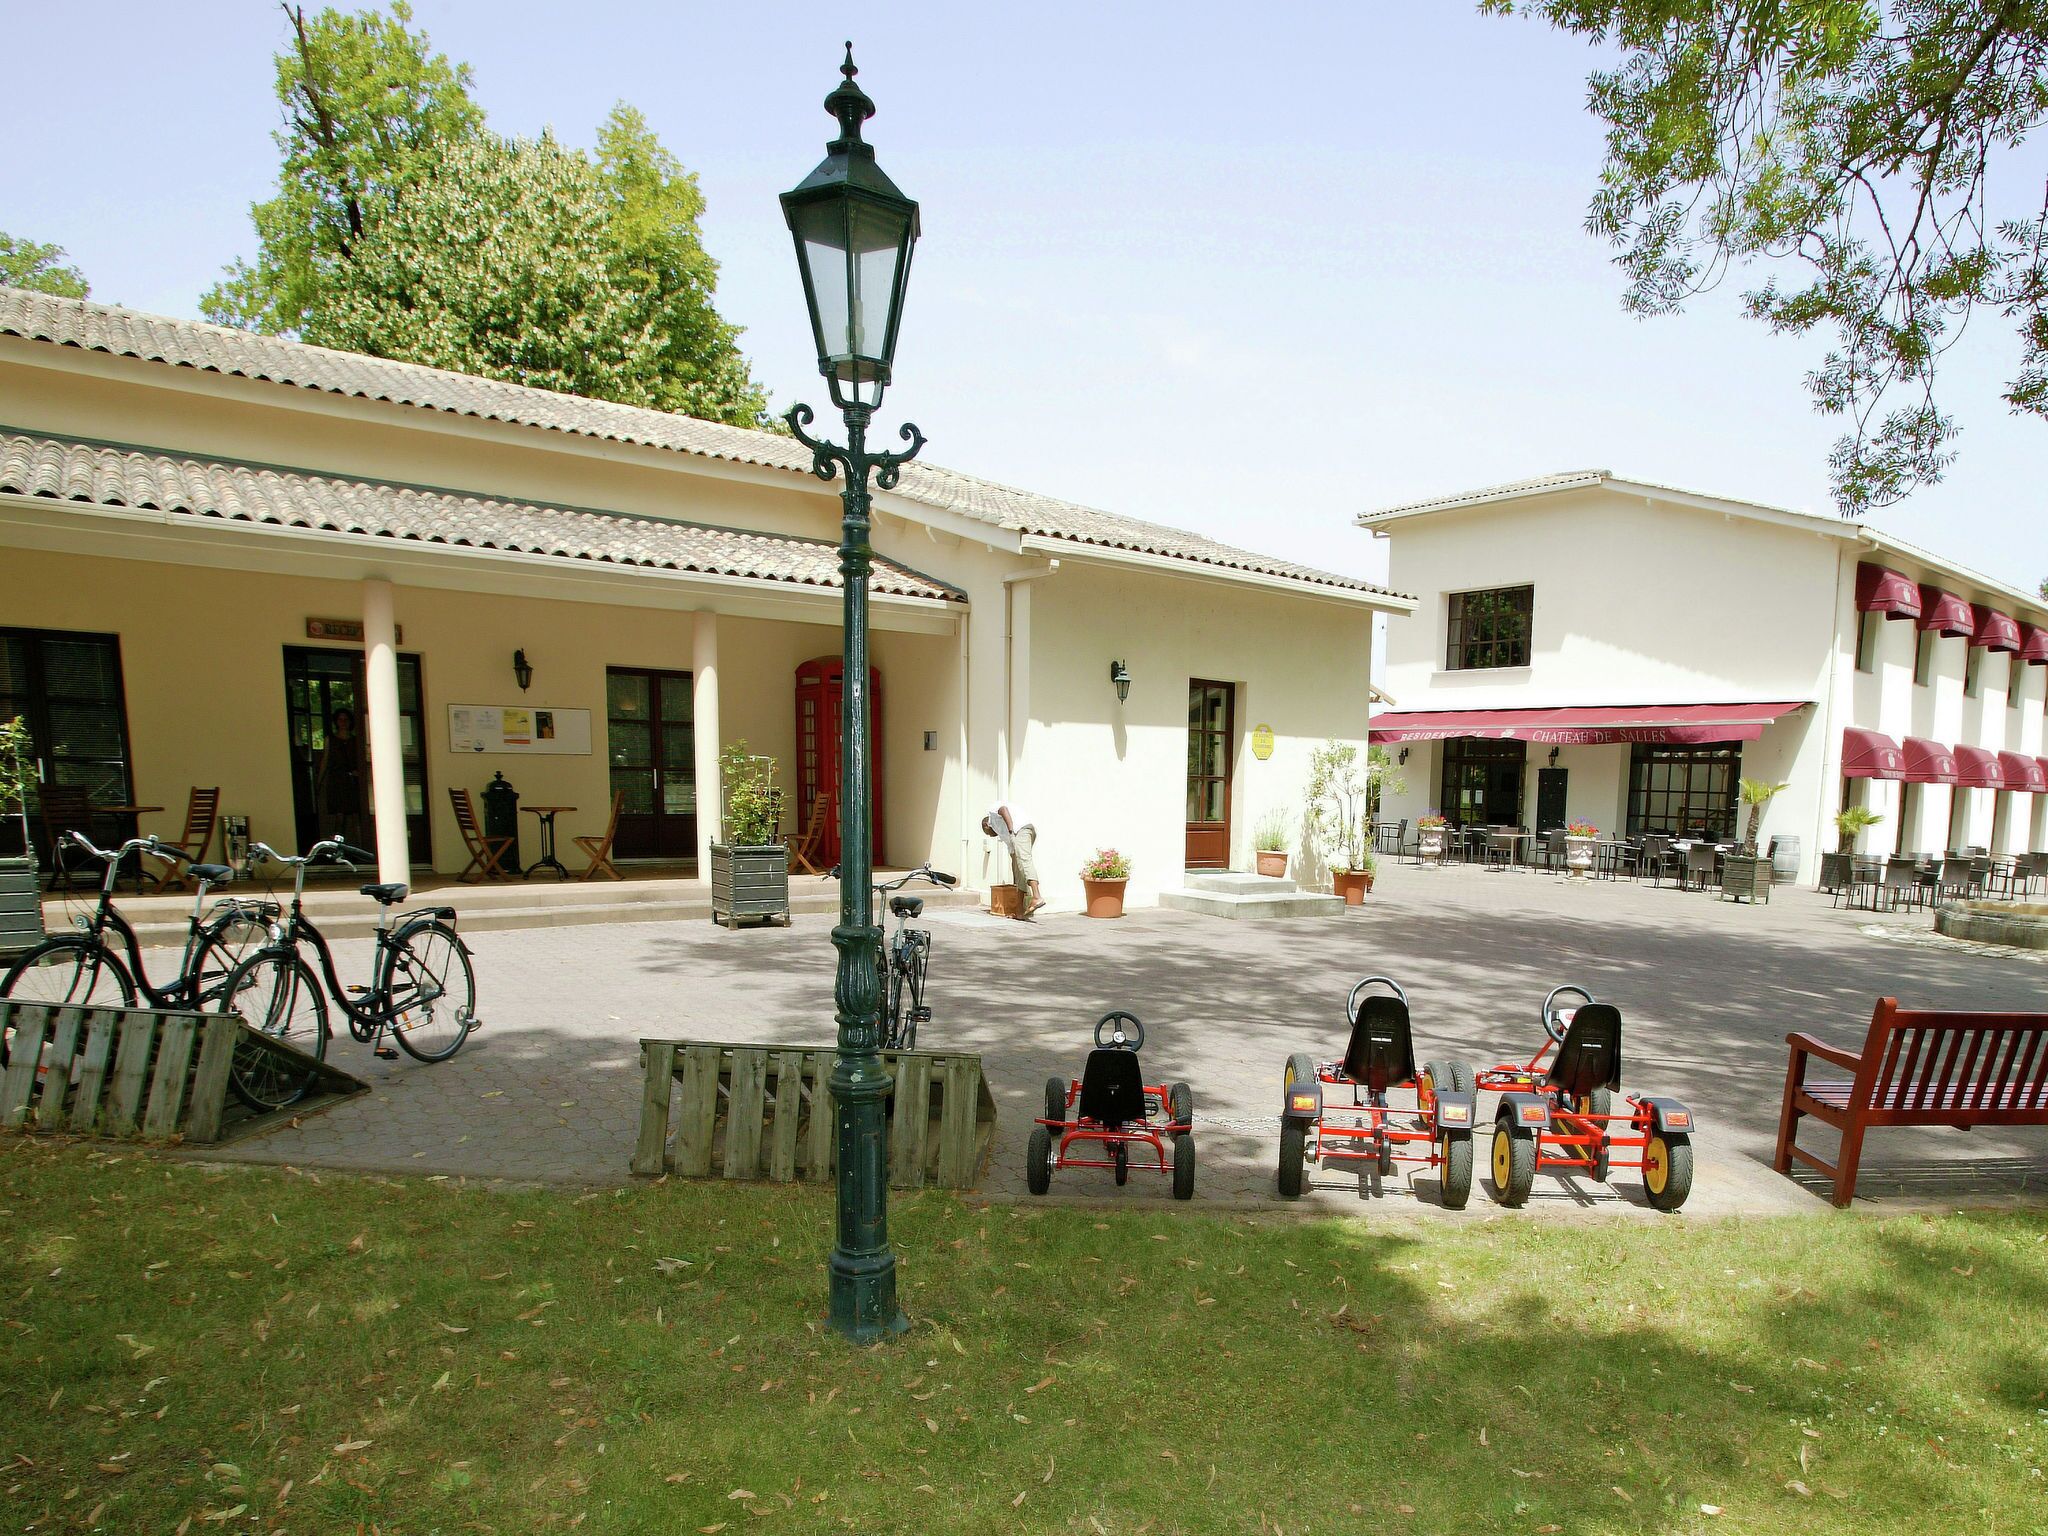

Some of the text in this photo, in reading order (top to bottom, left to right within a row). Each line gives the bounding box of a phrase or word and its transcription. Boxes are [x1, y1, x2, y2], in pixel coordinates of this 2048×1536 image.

[1532, 730, 1589, 743] CHATEAU
[1594, 731, 1613, 743] DE
[1620, 728, 1666, 743] SALLES
